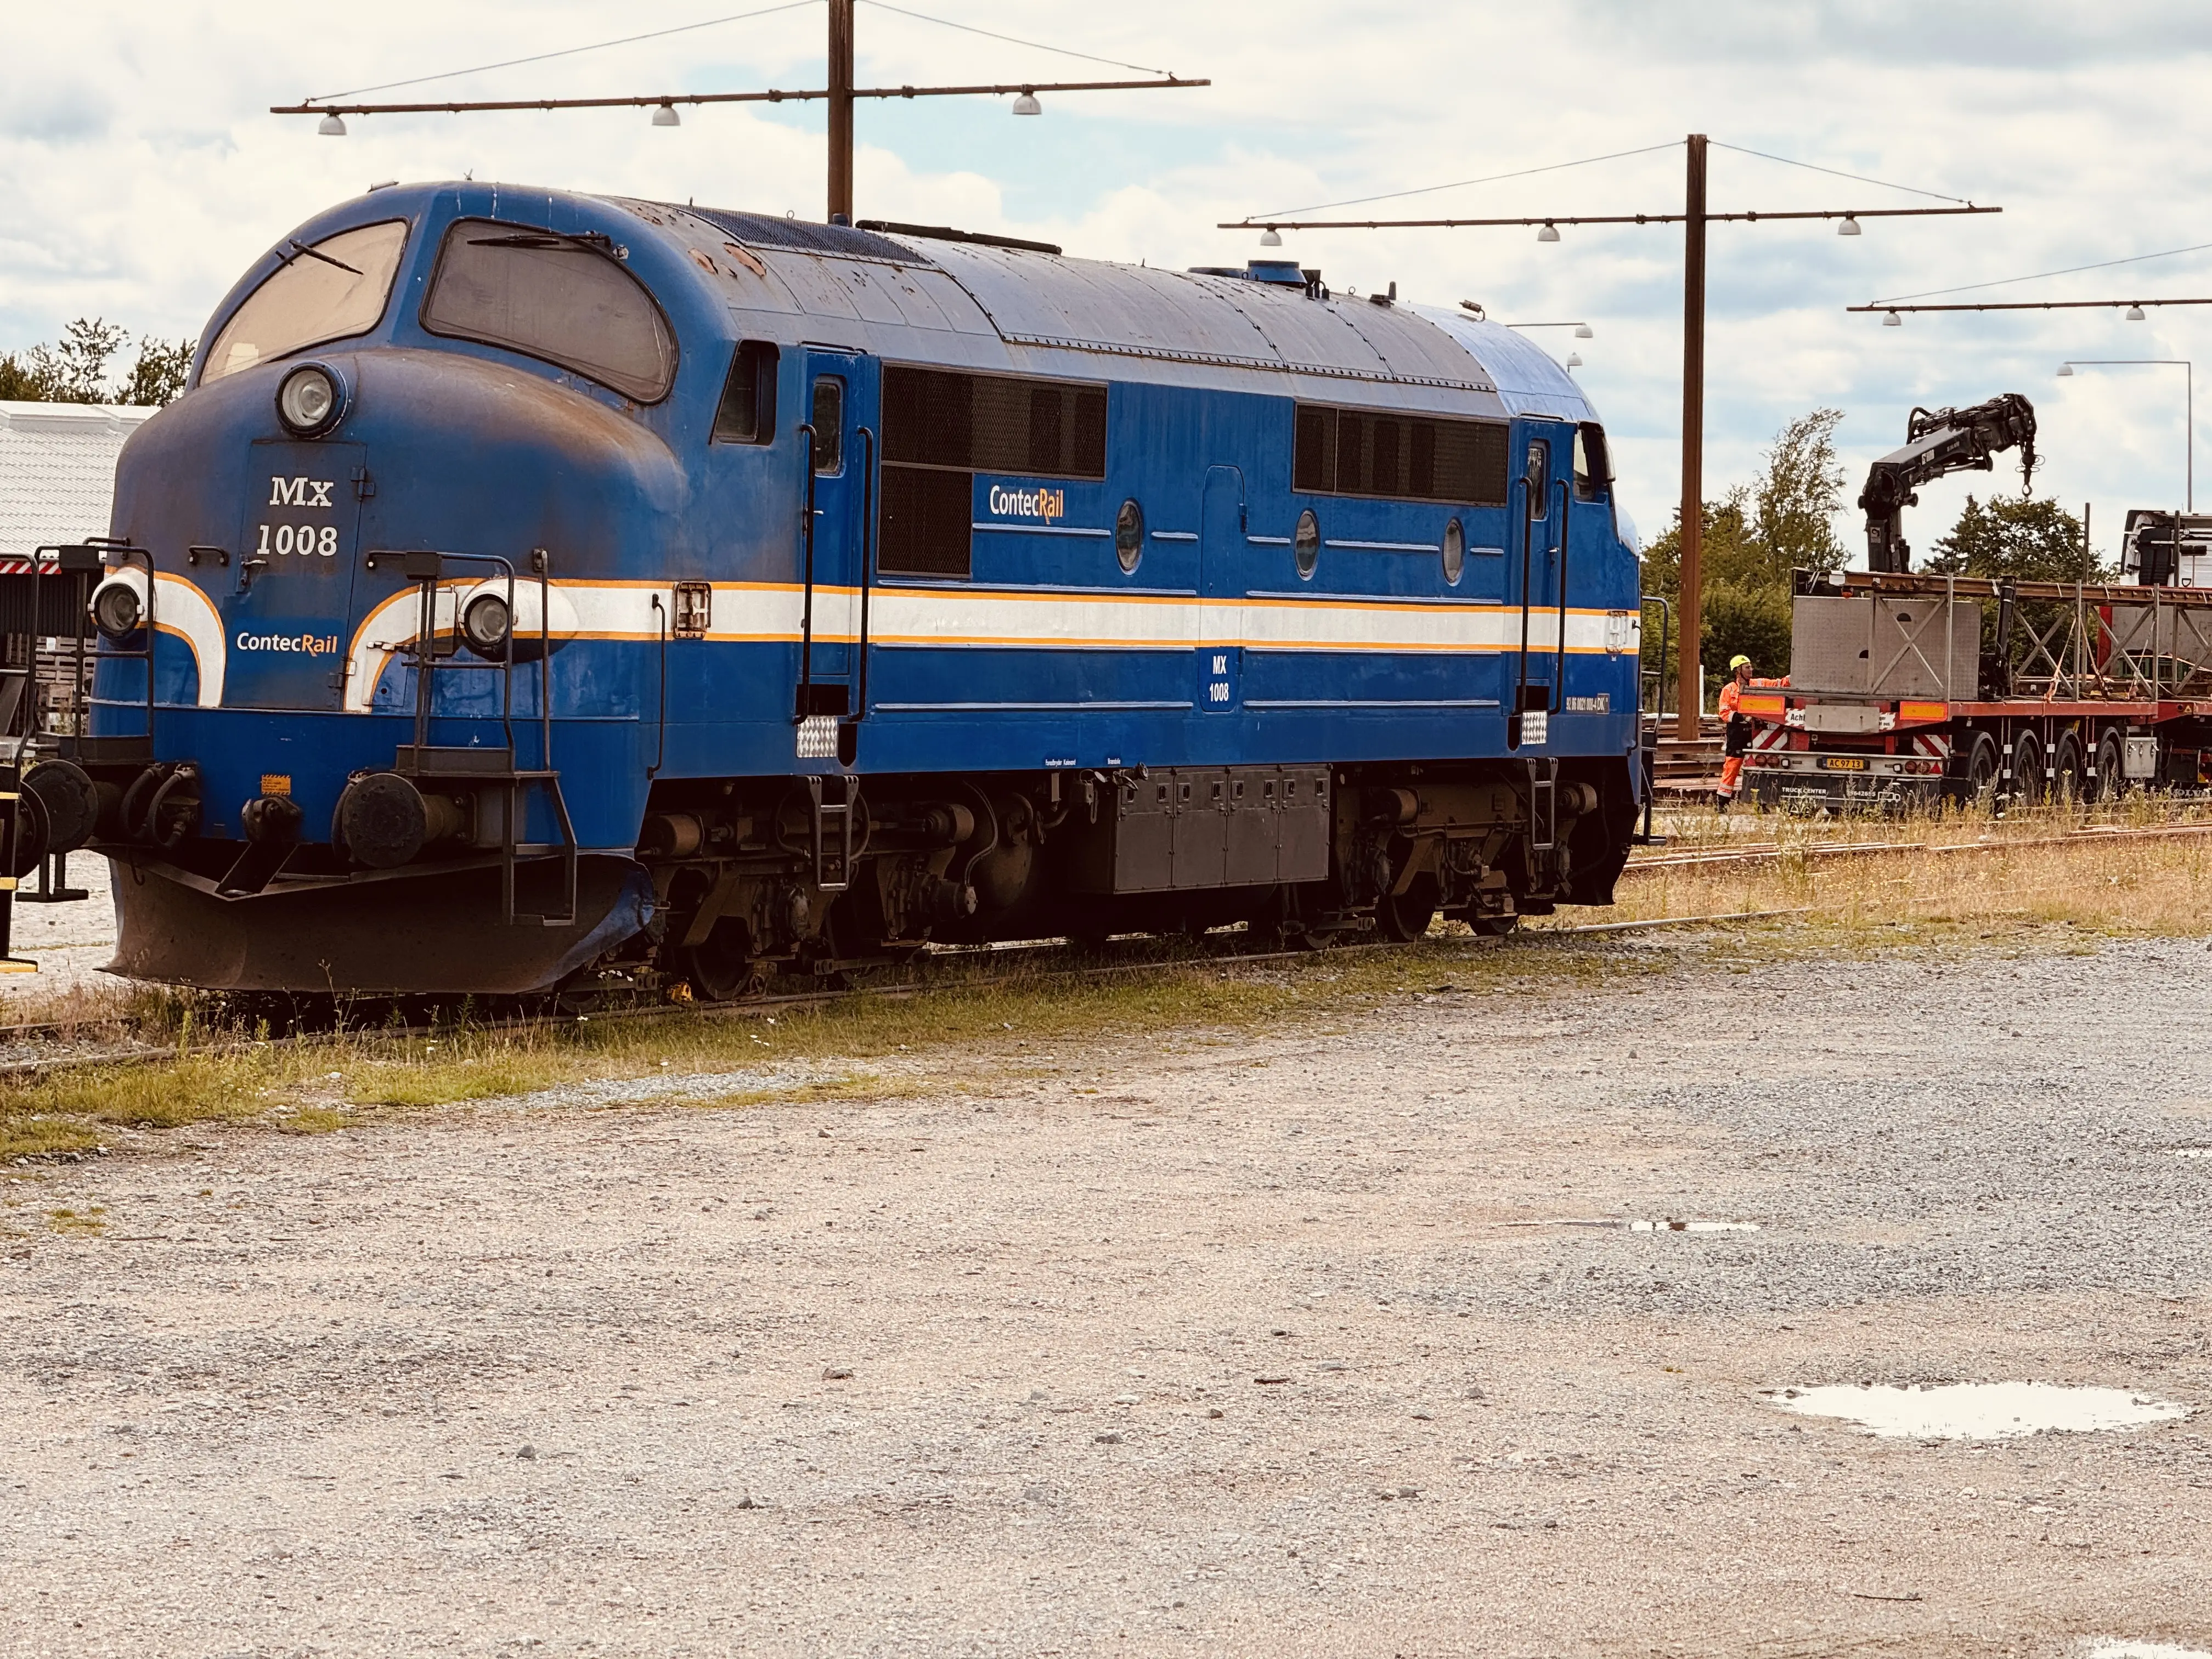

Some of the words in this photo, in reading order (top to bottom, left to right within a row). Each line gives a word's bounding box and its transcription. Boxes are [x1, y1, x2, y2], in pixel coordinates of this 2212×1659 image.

[990, 485, 1063, 525] ContecRail
[256, 524, 338, 556] 1008
[236, 632, 338, 657] ContecRail
[1212, 655, 1227, 674] MX
[1209, 682, 1229, 702] 1008
